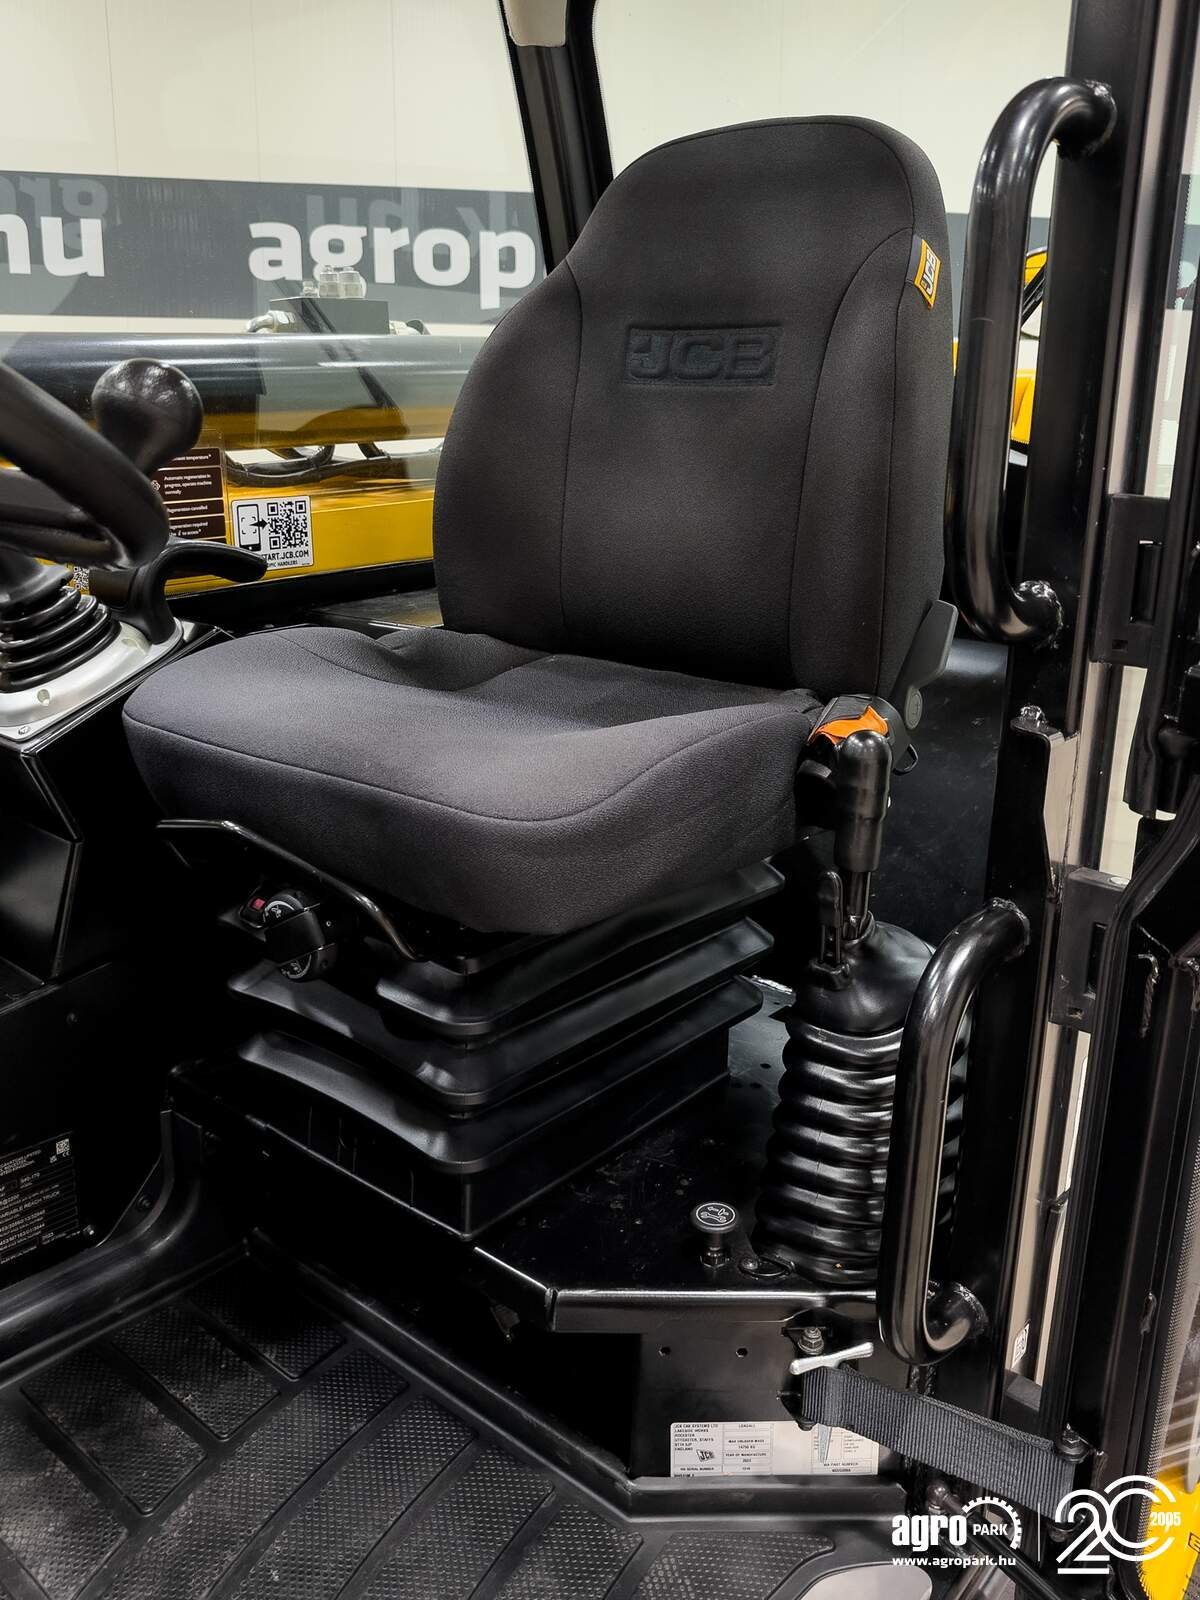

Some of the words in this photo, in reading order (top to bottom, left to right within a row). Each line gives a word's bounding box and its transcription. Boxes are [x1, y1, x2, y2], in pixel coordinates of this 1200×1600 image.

[248, 222, 547, 309] agrop
[920, 248, 937, 295] JCB
[629, 333, 774, 382] JCB
[699, 1450, 715, 1461] JCB
